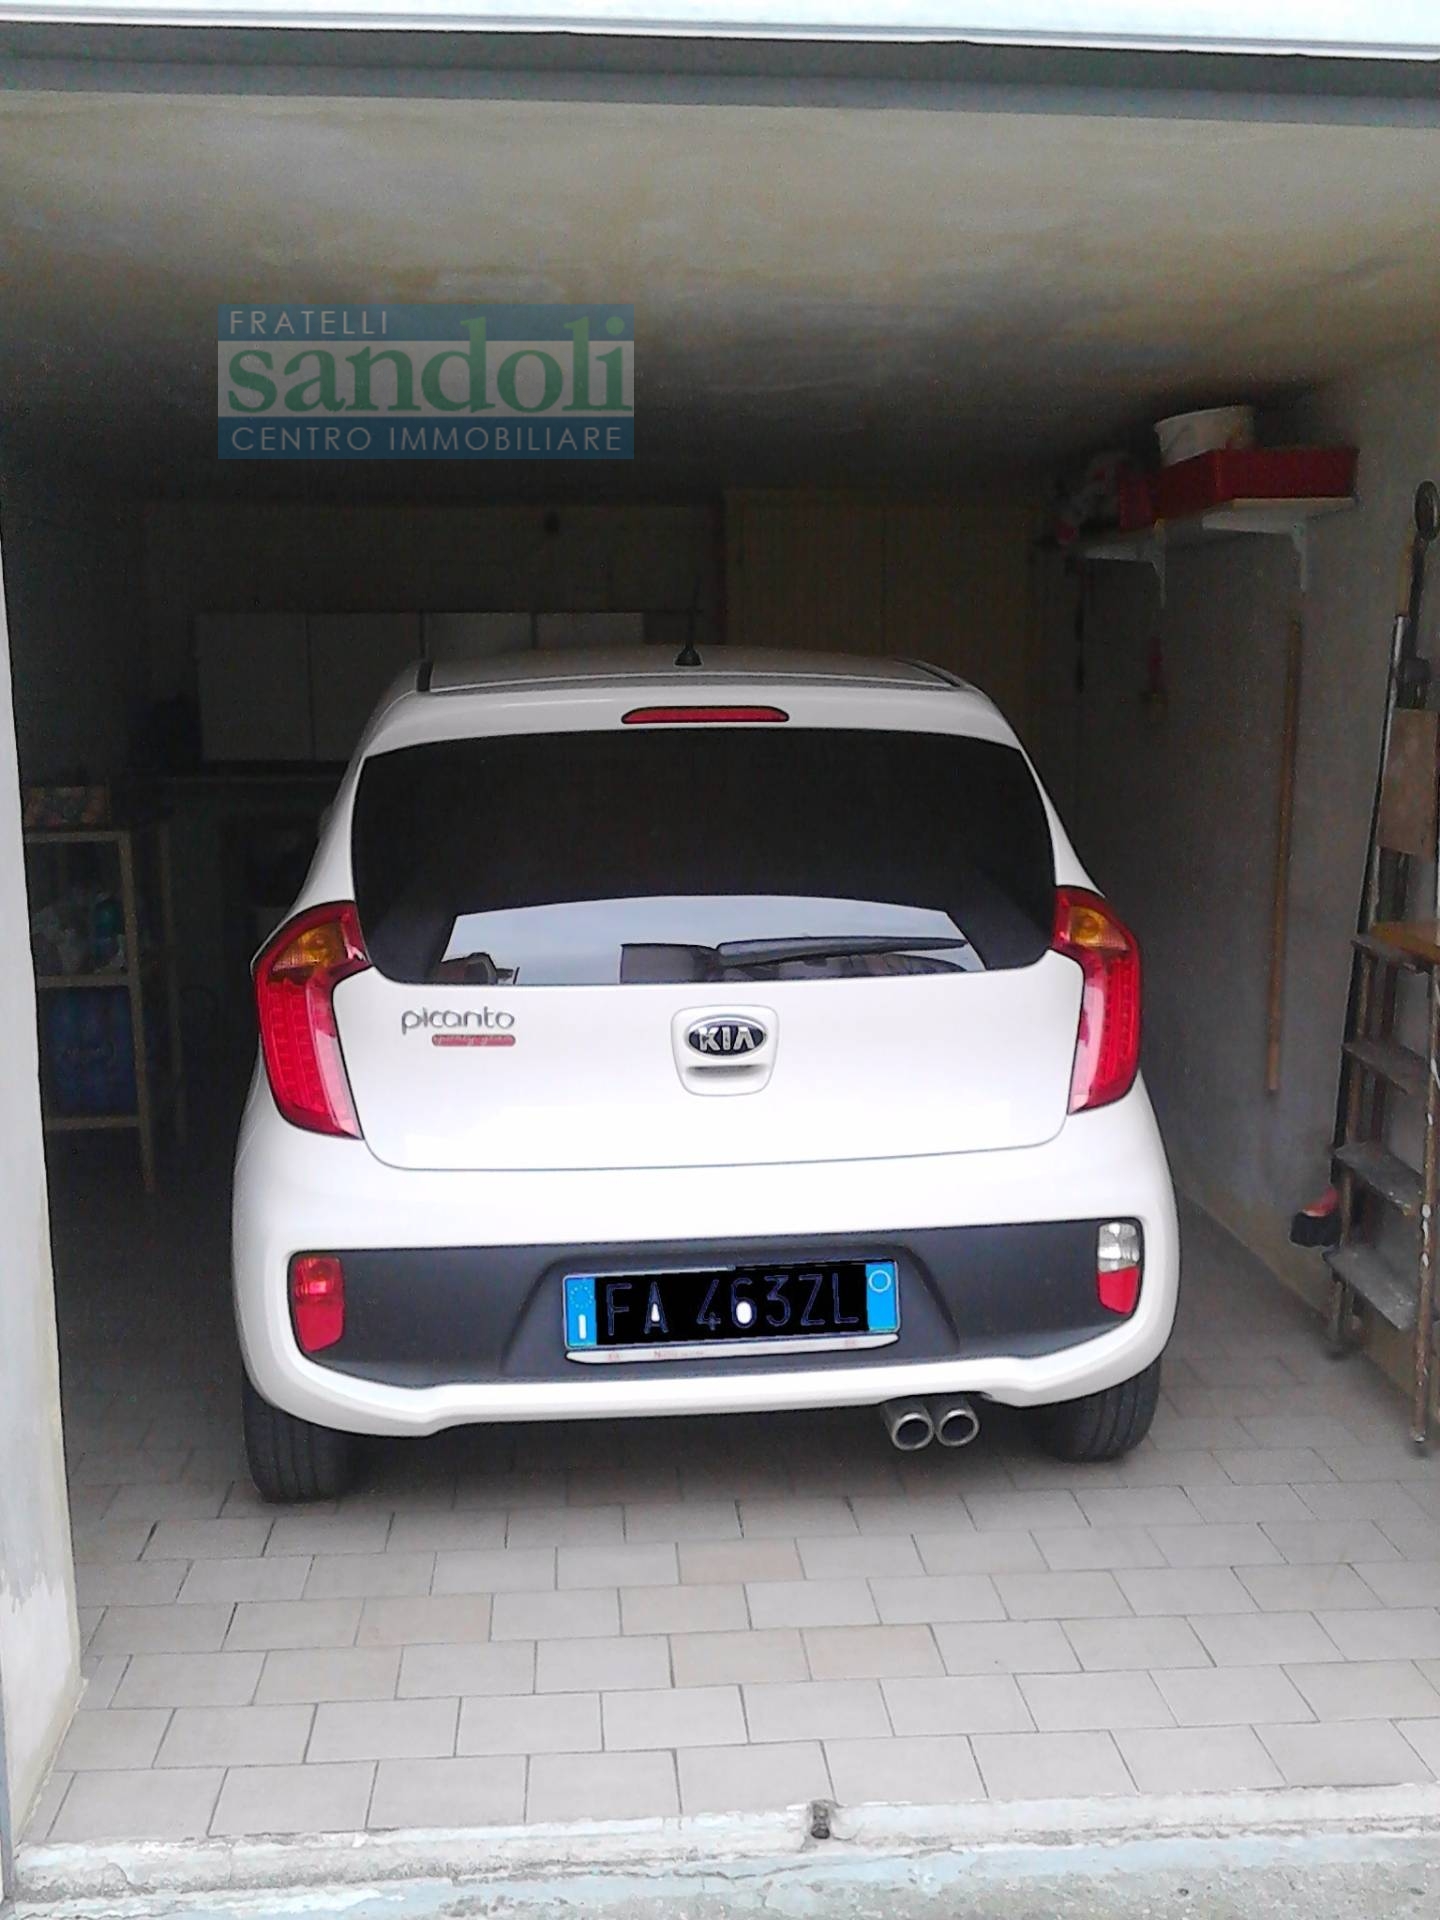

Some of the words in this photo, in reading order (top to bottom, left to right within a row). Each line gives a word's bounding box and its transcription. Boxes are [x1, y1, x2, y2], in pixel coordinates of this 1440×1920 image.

[401, 1005, 515, 1036] picanto
[698, 1026, 756, 1051] KIA
[606, 1280, 670, 1337] FA
[696, 1272, 860, 1332] 463ZL
